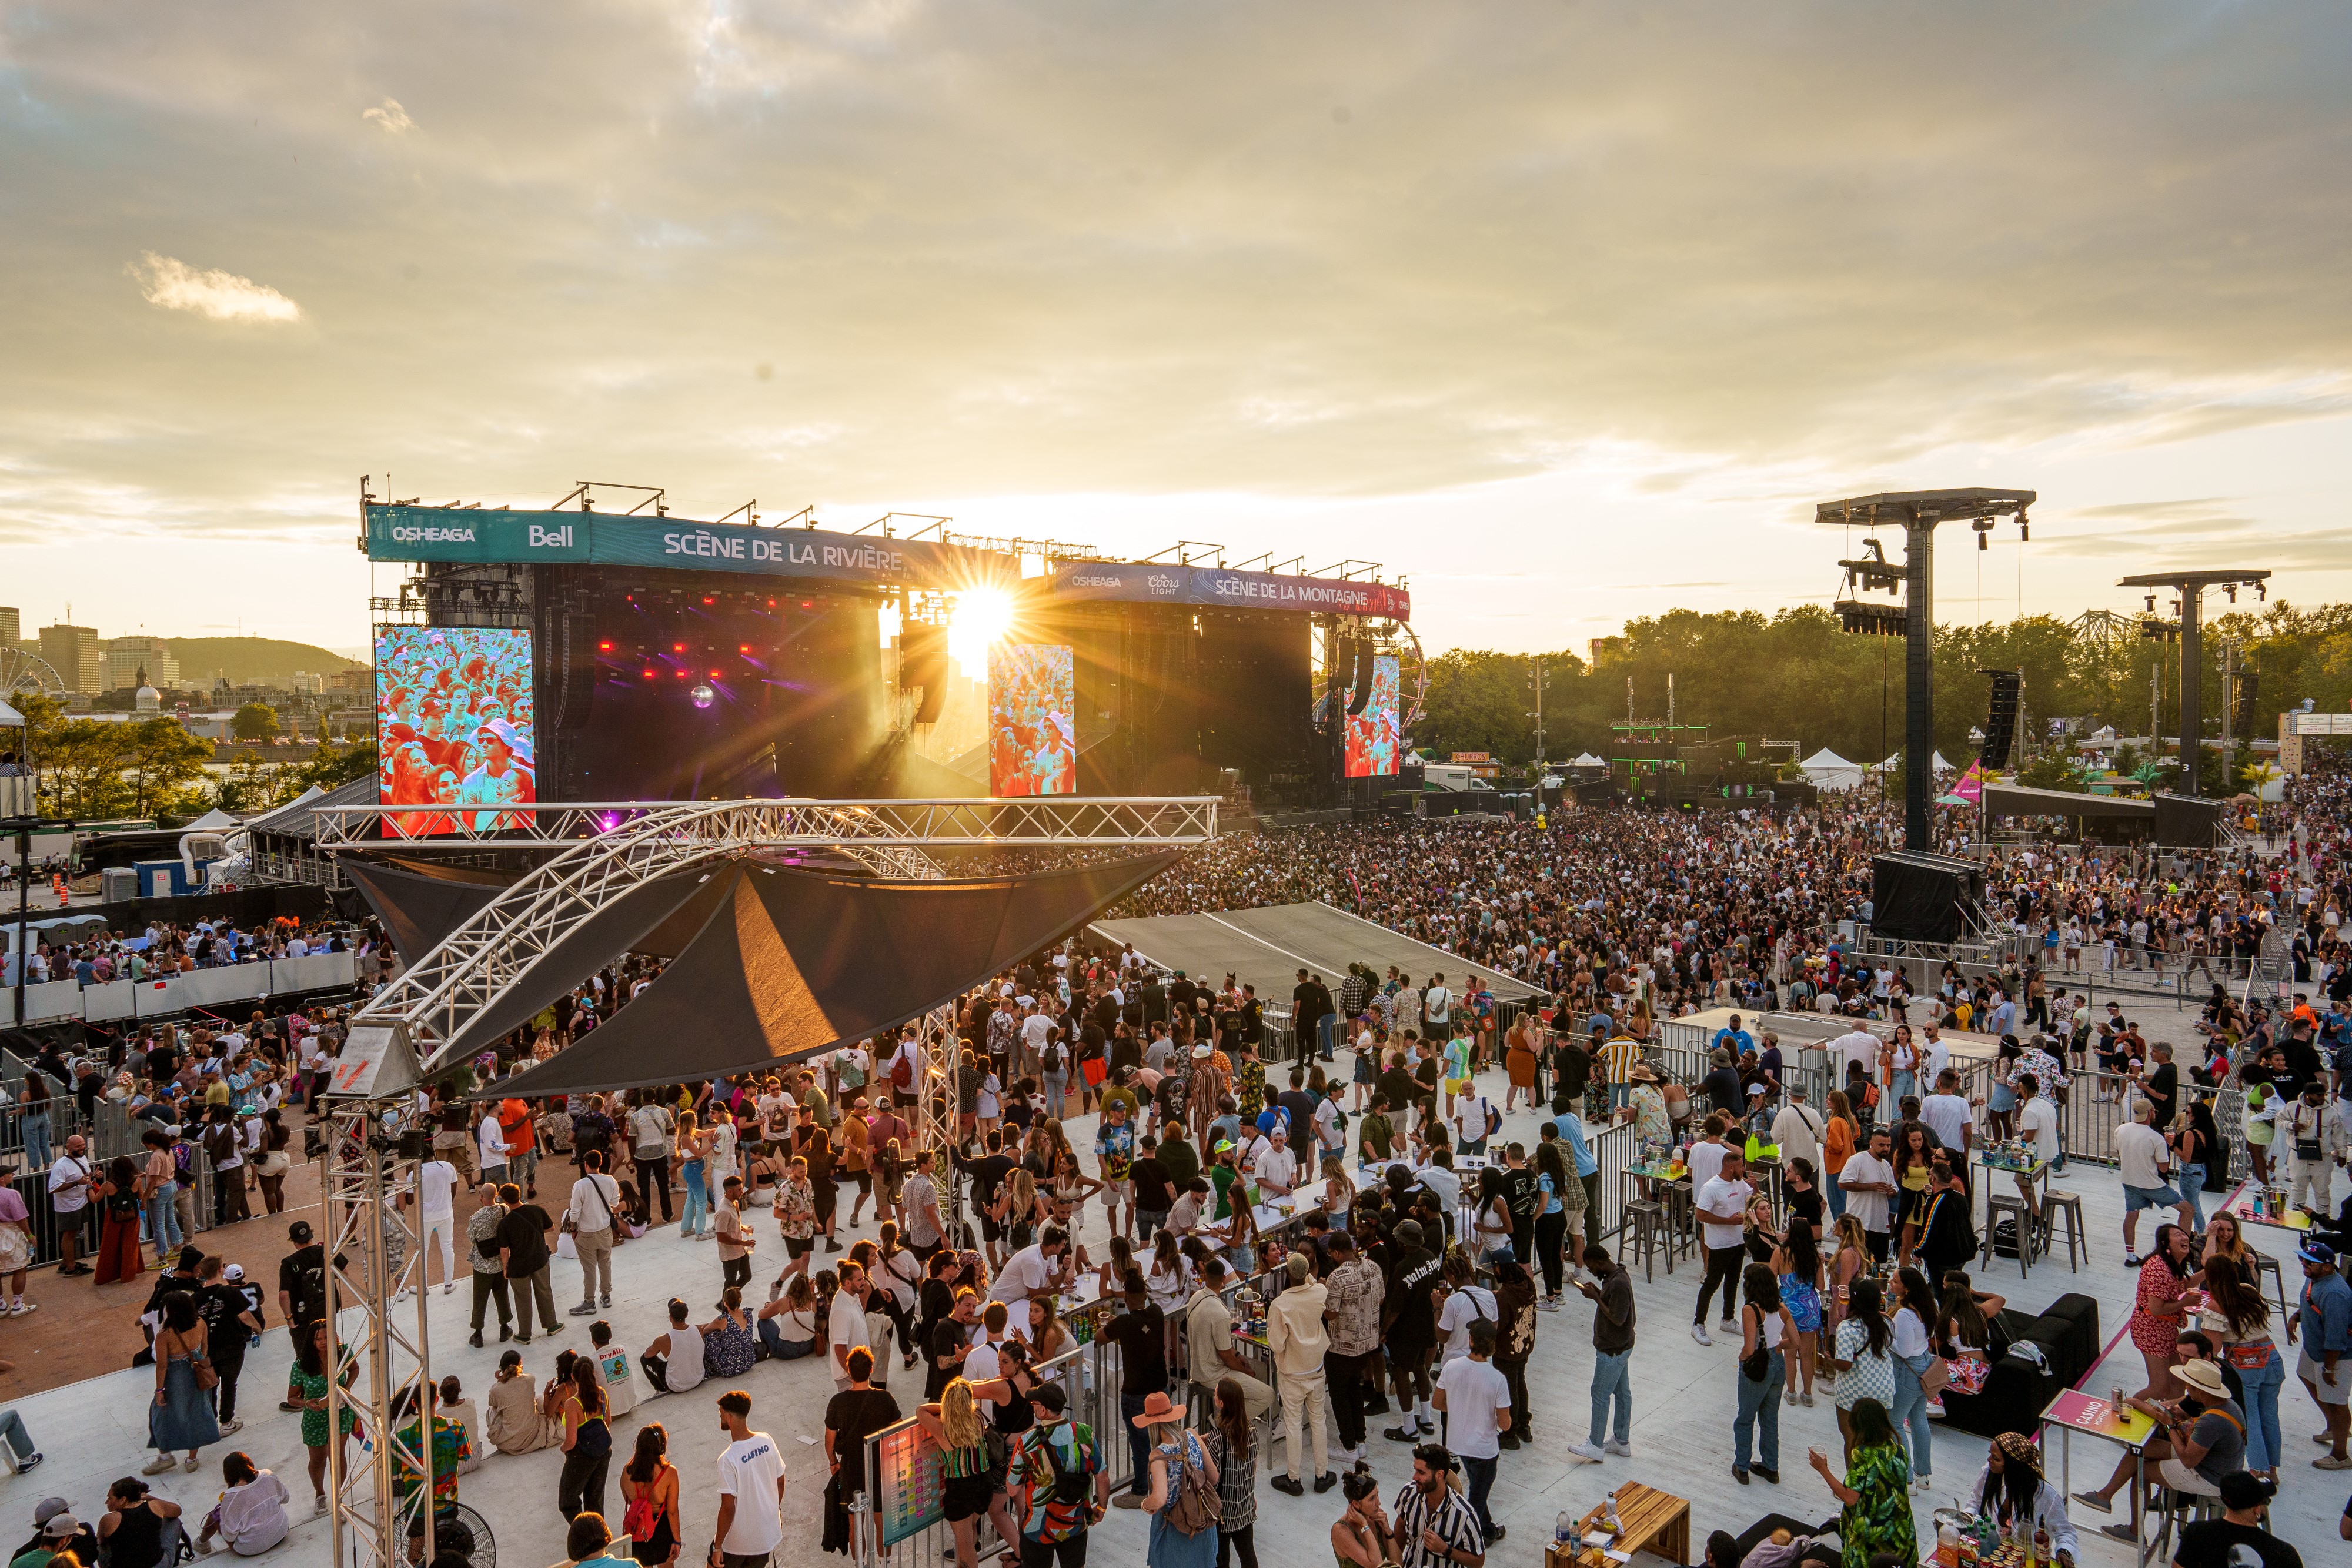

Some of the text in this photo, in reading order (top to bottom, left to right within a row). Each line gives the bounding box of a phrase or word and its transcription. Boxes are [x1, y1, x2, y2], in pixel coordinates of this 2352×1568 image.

[392, 527, 476, 542] OSHEAGA
[529, 525, 573, 547] Bell
[664, 529, 902, 571] SCÈNE DE LA RIVIÈRE
[1072, 576, 1121, 587] OSHEAGA
[1148, 574, 1180, 588] Coors
[1151, 587, 1177, 595] LIGHT
[1215, 577, 1368, 606] SCÈNE DE LA MONTAGNE
[2182, 764, 2189, 772] 3
[1061, 987, 1070, 998] 10
[1126, 993, 1141, 1004] 32
[2076, 1401, 2102, 1425] CASINO
[2094, 1408, 2112, 1426] MONTRÉAL
[888, 1437, 907, 1447] OSHEAGA
[741, 1445, 769, 1463] CASINO
